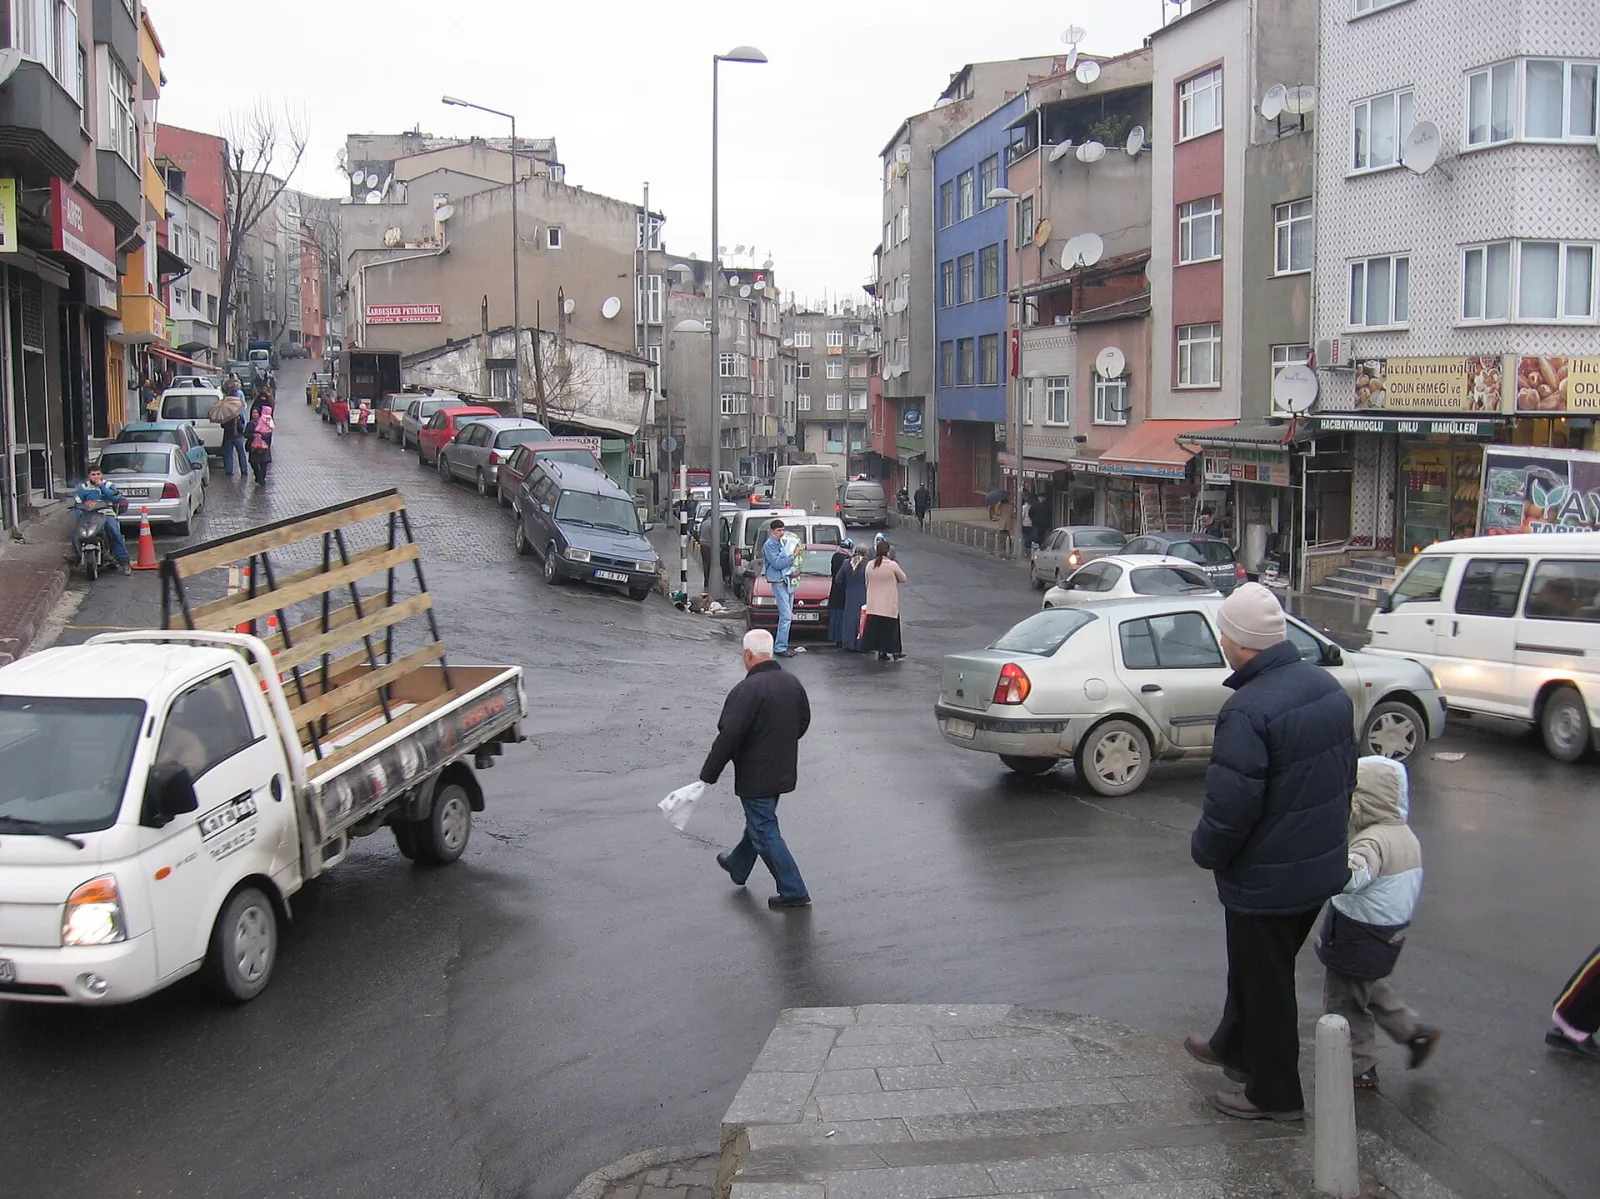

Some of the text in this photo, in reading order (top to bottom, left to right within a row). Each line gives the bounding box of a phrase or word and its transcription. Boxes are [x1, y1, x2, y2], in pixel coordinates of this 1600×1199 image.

[1390, 382, 1414, 394] ODUN
[1451, 385, 1461, 394] ve
[1390, 398, 1410, 406] UNLU
[1575, 398, 1600, 407] UNL
[1397, 421, 1418, 432] UNLU
